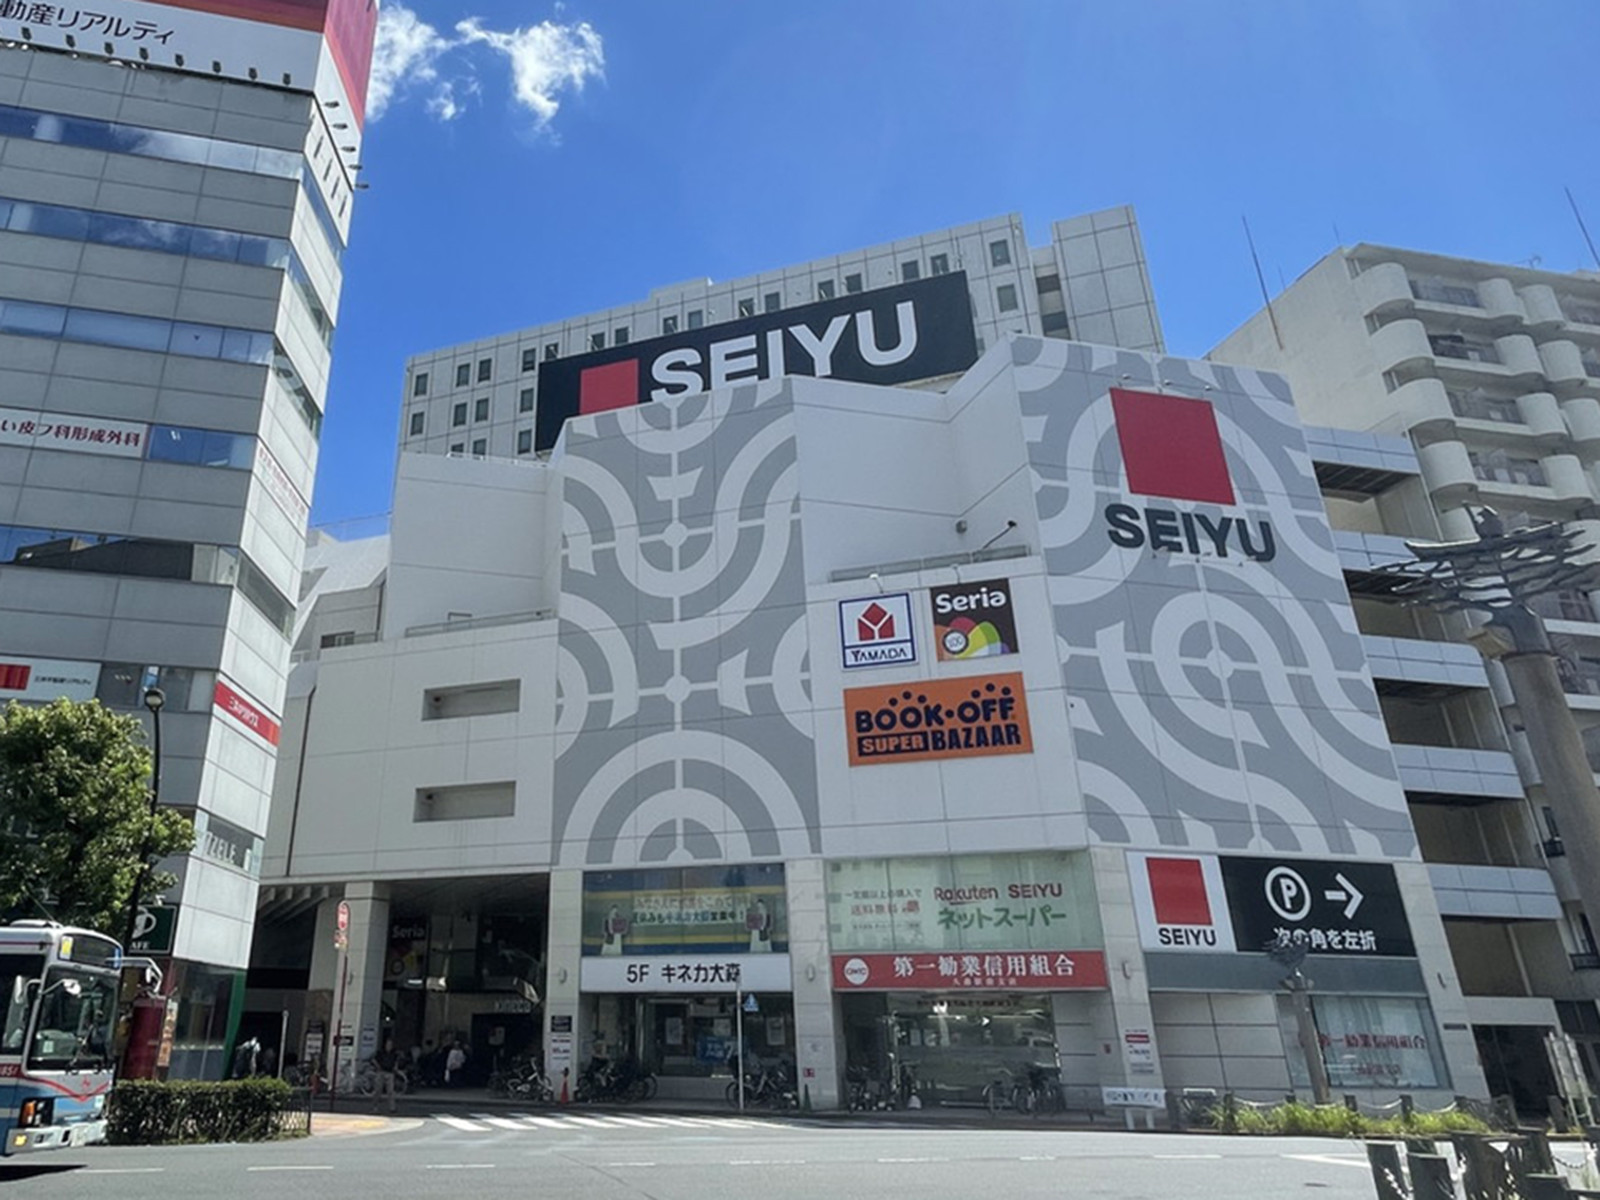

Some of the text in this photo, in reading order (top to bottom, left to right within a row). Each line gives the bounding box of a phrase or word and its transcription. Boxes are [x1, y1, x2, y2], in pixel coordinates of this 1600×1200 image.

[651, 302, 918, 403] SEIYU
[1105, 503, 1276, 562] SEIYU
[936, 587, 1007, 613] Seria
[851, 648, 908, 662] YAMADA
[861, 724, 1021, 754] SUPER BAZAAR
[934, 883, 1063, 905] Rakuten SEIYU
[937, 904, 1067, 930] ネットスーパー
[1158, 927, 1217, 946] SEIYU
[1273, 927, 1377, 951] 次の角を左折
[626, 962, 741, 983] 5F キネカ大森
[893, 953, 1075, 977] 第一勧業信用組合
